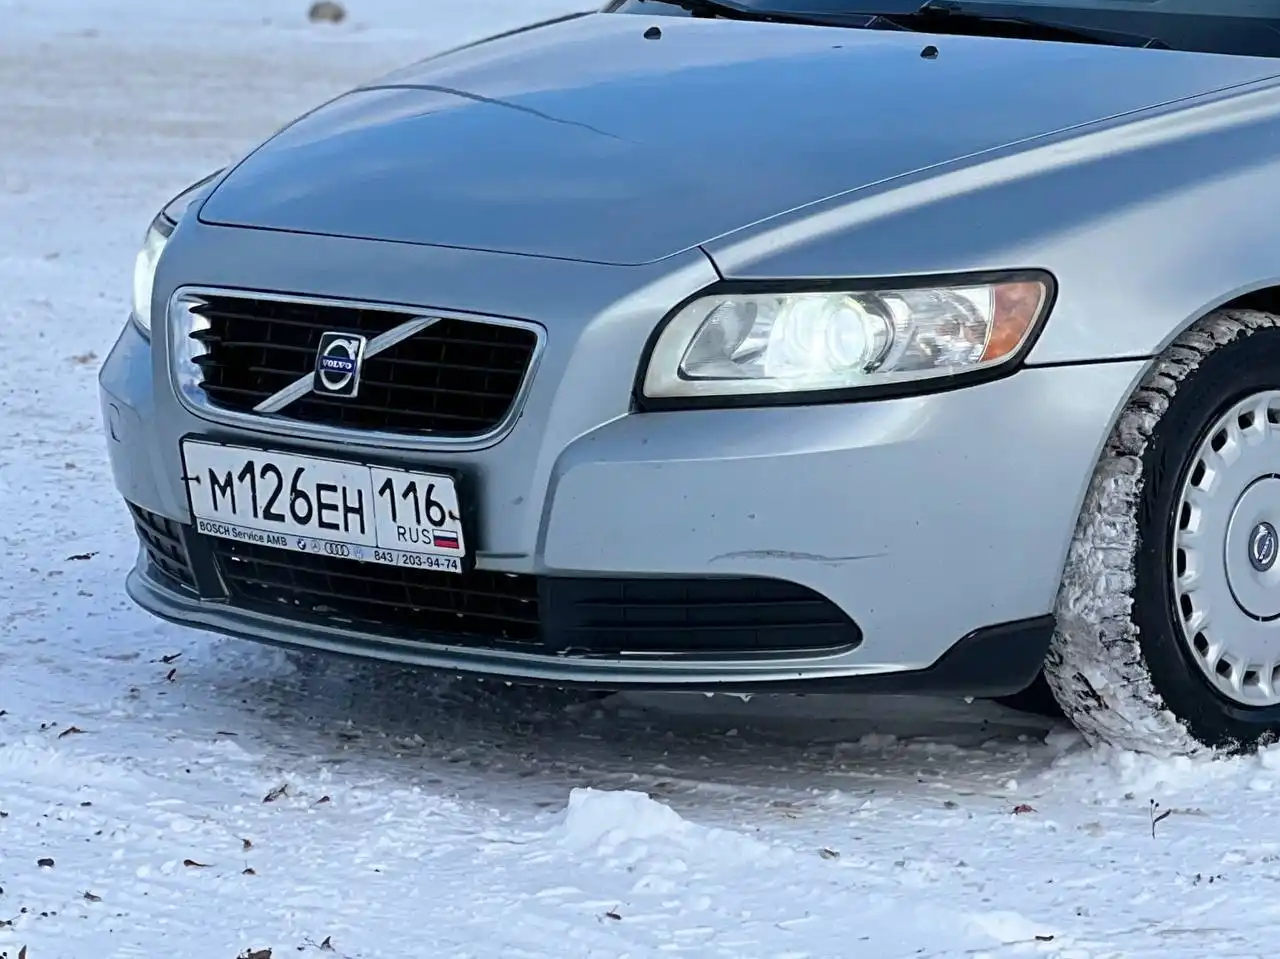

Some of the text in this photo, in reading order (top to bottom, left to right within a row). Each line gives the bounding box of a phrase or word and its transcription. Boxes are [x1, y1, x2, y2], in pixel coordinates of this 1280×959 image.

[322, 359, 352, 370] VOLVO
[379, 478, 447, 527] 116
[199, 521, 288, 547] BOSCH Service AMB
[397, 525, 432, 545] RUS
[374, 550, 393, 563] 843
[403, 554, 458, 570] 203-94-74
